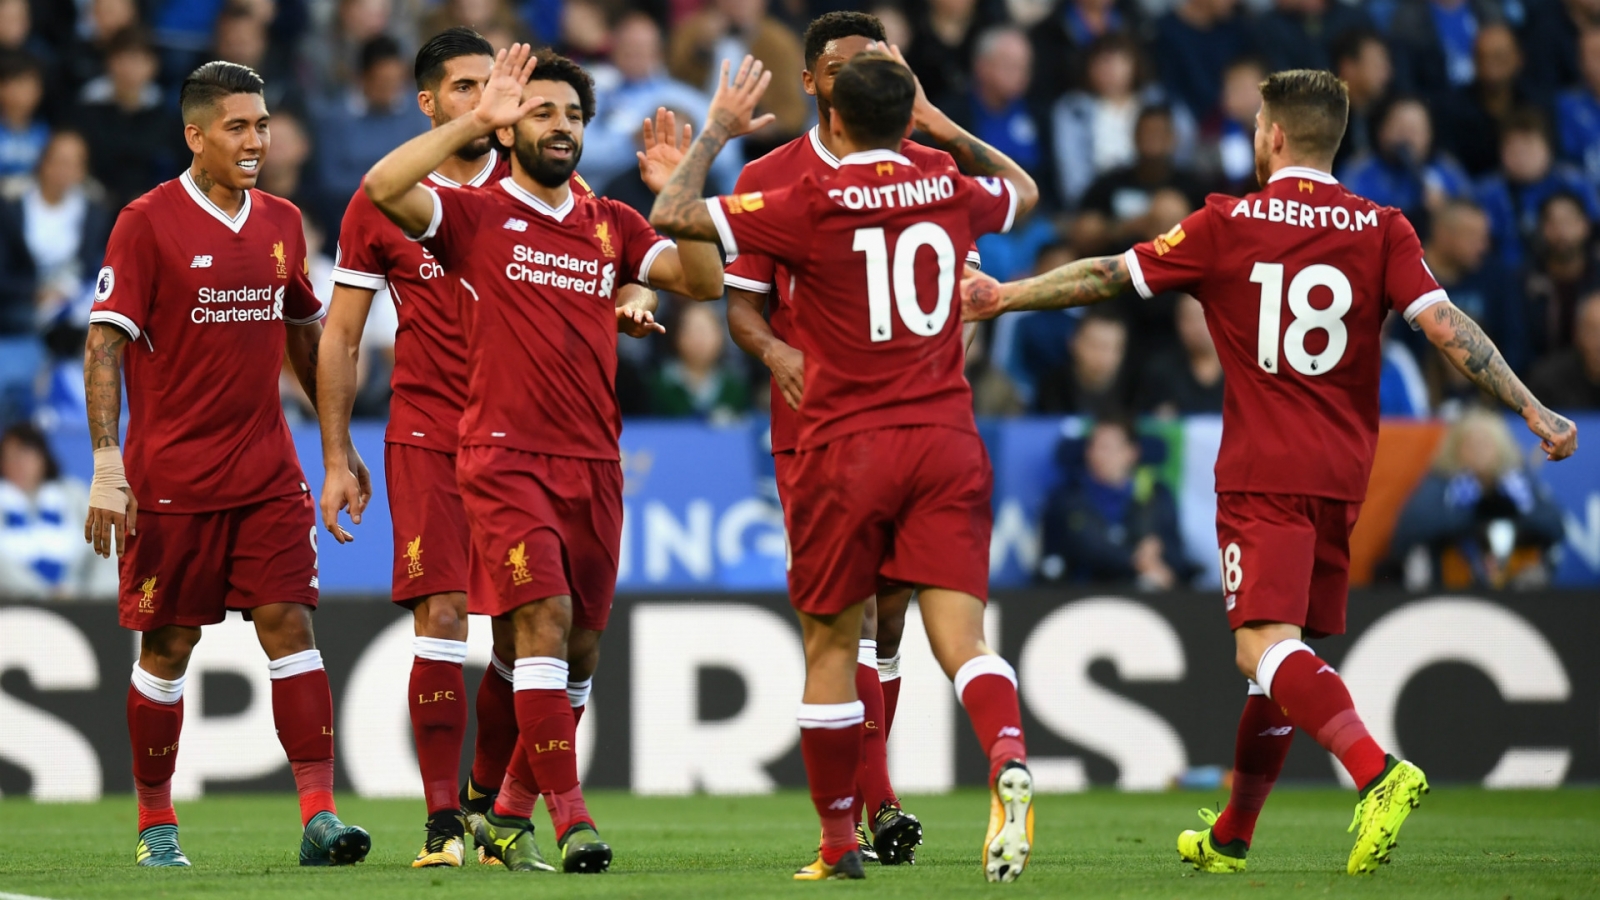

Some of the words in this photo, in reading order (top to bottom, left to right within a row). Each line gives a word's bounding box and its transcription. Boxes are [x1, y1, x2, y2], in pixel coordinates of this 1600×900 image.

[1231, 198, 1378, 231] ALBERTO.M
[513, 245, 598, 276] Standard
[198, 285, 272, 303] Standard
[506, 263, 597, 295] Chartered
[852, 222, 956, 342] 10
[191, 305, 271, 324] Chartered
[1249, 261, 1353, 376] 18
